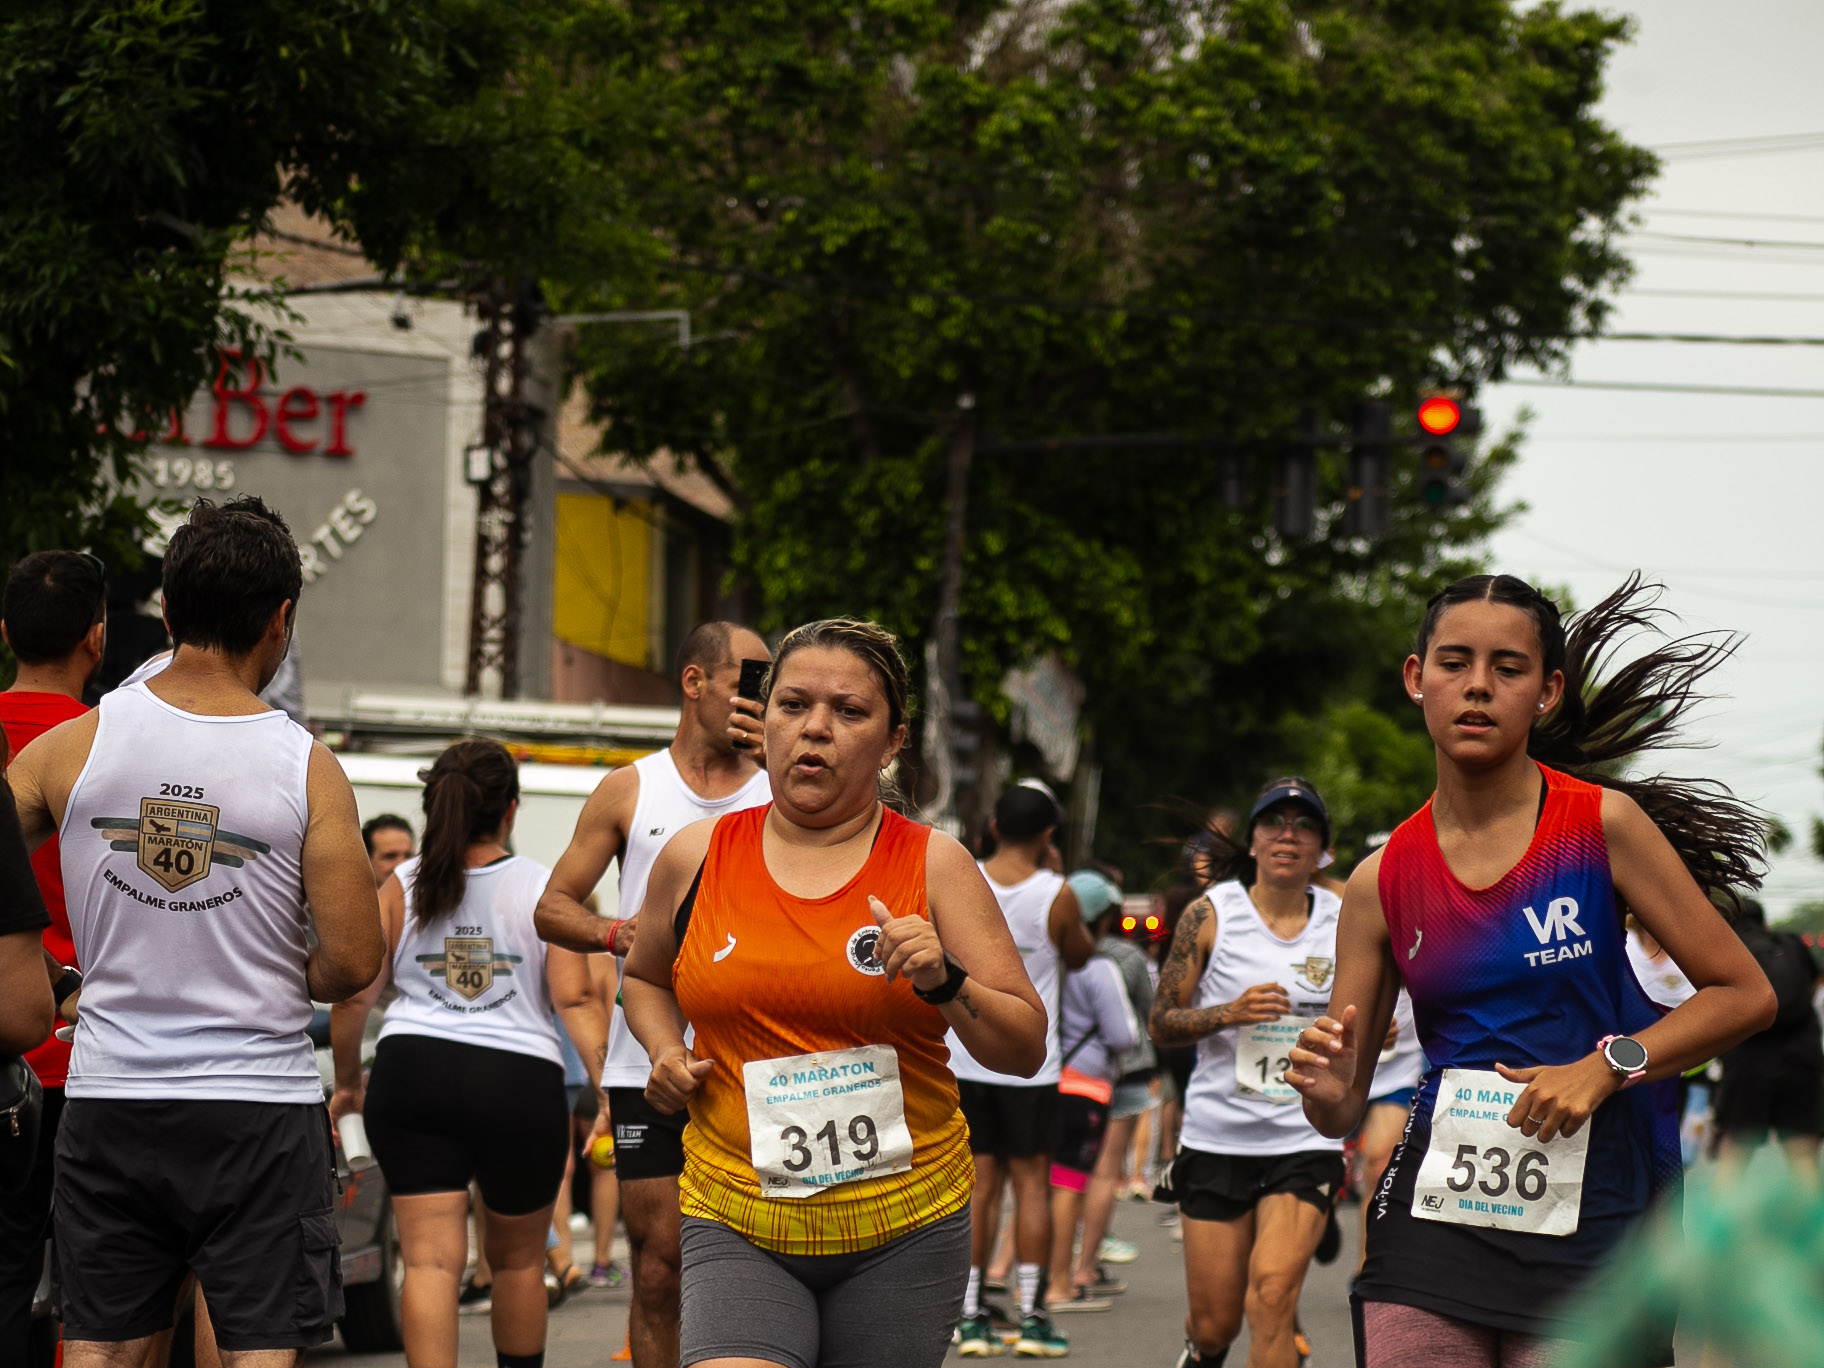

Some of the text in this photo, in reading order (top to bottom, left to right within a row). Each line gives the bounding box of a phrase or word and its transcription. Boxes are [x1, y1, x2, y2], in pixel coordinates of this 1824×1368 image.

[152, 457, 236, 490] 1985
[300, 488, 378, 583] RTES
[159, 783, 205, 800] 2025
[149, 806, 209, 823] ARGENTINA
[147, 835, 204, 851] MARATÓN
[152, 848, 195, 876] 40
[103, 868, 243, 912] EMPALME GRANEROS
[1522, 896, 1586, 945] VR
[455, 926, 483, 936] 2025
[1523, 940, 1593, 967] TEAM
[456, 971, 483, 989] 40
[769, 1061, 875, 1088] 40 MARATON
[1256, 1056, 1291, 1085] 13
[766, 1079, 882, 1105] EMPALME GRANEROS
[1455, 1088, 1515, 1105] 40 MAR
[1450, 1108, 1499, 1121] EMPALME
[616, 1124, 642, 1138] VR TEAM
[780, 1114, 879, 1173] 319
[768, 1176, 790, 1186] NEJ
[818, 1173, 834, 1184] DEL
[1446, 1144, 1549, 1201] 536
[1420, 1194, 1445, 1209] NEJ
[1458, 1198, 1524, 1217] DIA DEL VECINO
